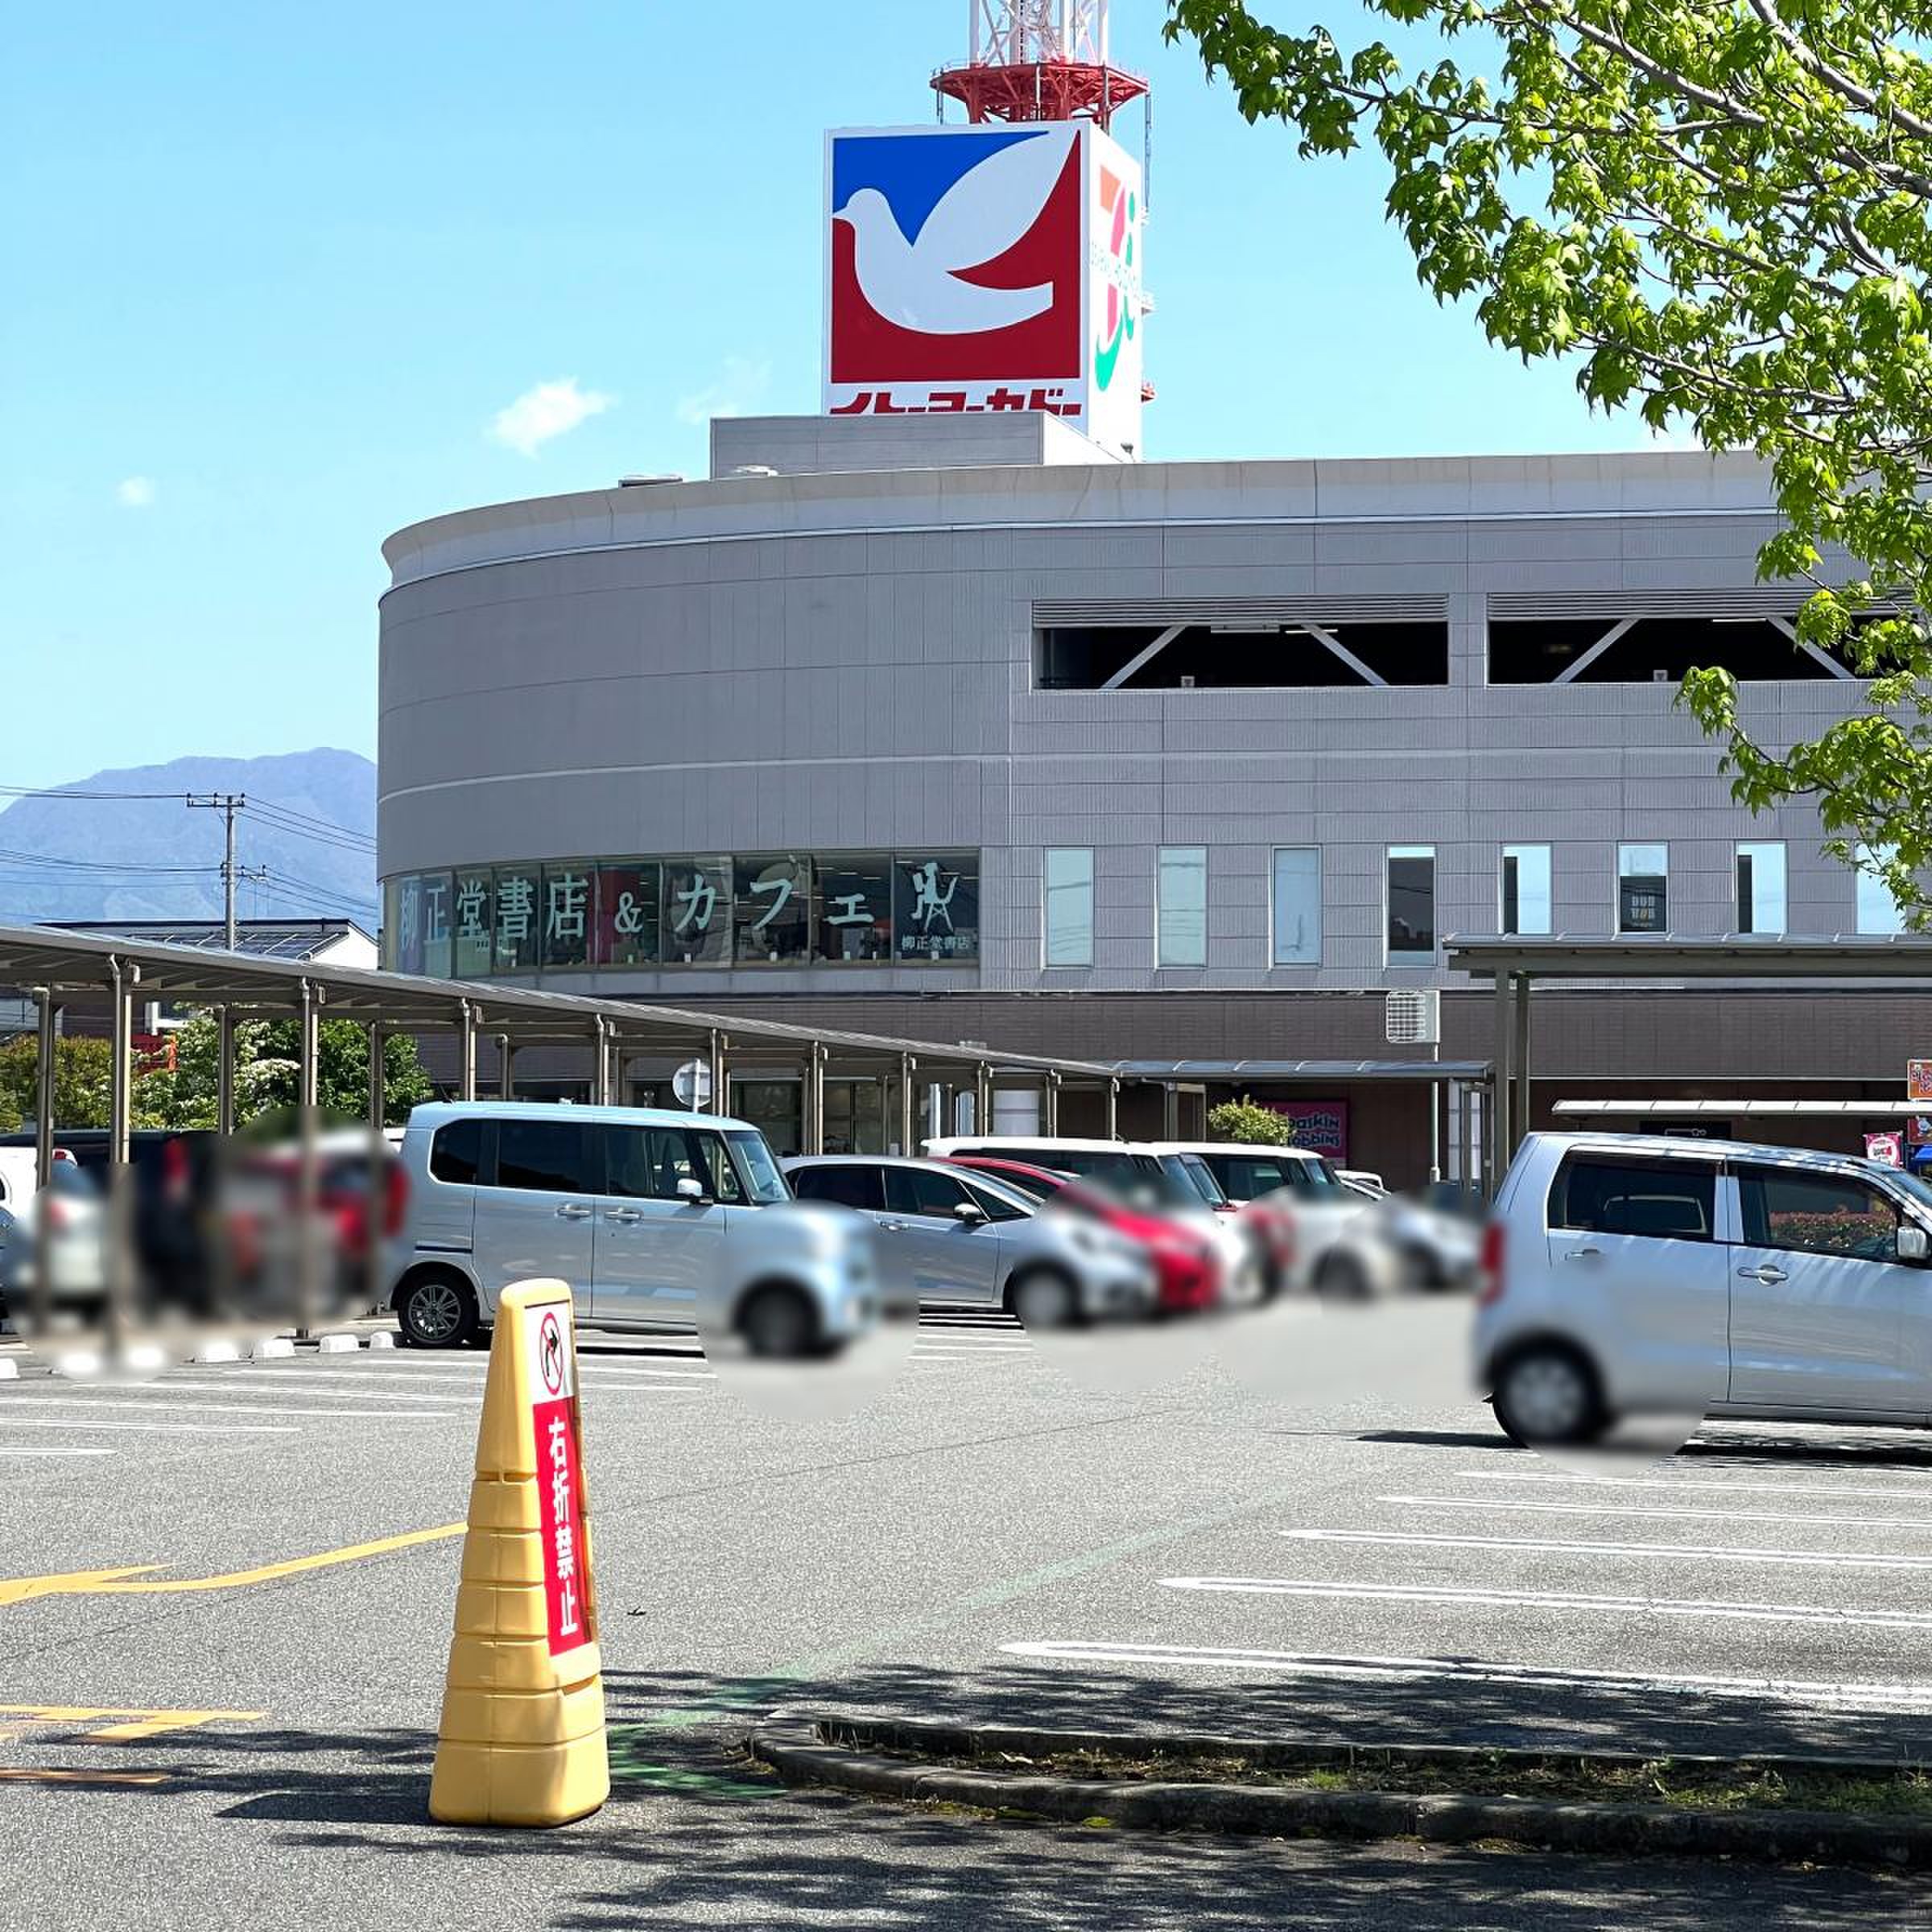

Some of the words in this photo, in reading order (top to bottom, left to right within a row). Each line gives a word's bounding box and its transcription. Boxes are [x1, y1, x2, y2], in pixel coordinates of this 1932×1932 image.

[614, 891, 642, 934] &
[548, 1416, 579, 1637] 右折禁止
